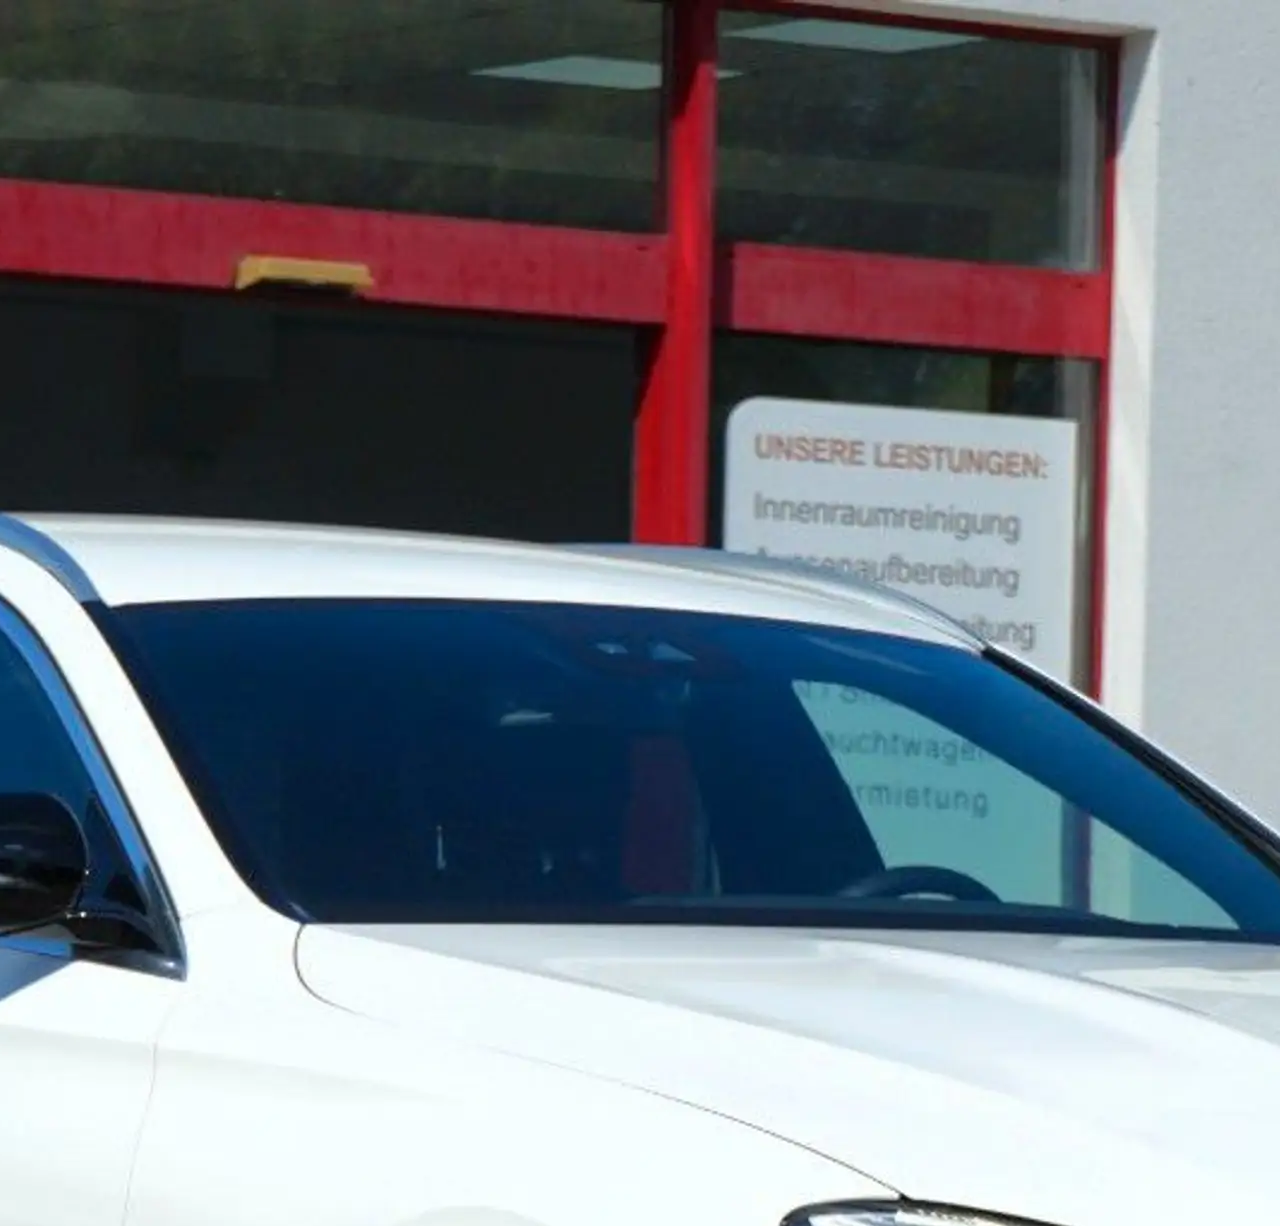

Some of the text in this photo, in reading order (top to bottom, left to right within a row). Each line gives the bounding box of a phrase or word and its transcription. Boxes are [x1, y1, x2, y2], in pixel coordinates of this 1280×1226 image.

[754, 433, 1049, 480] UNSERE LEISTUNGEN:
[753, 491, 1022, 545] Innenraumreinigung
